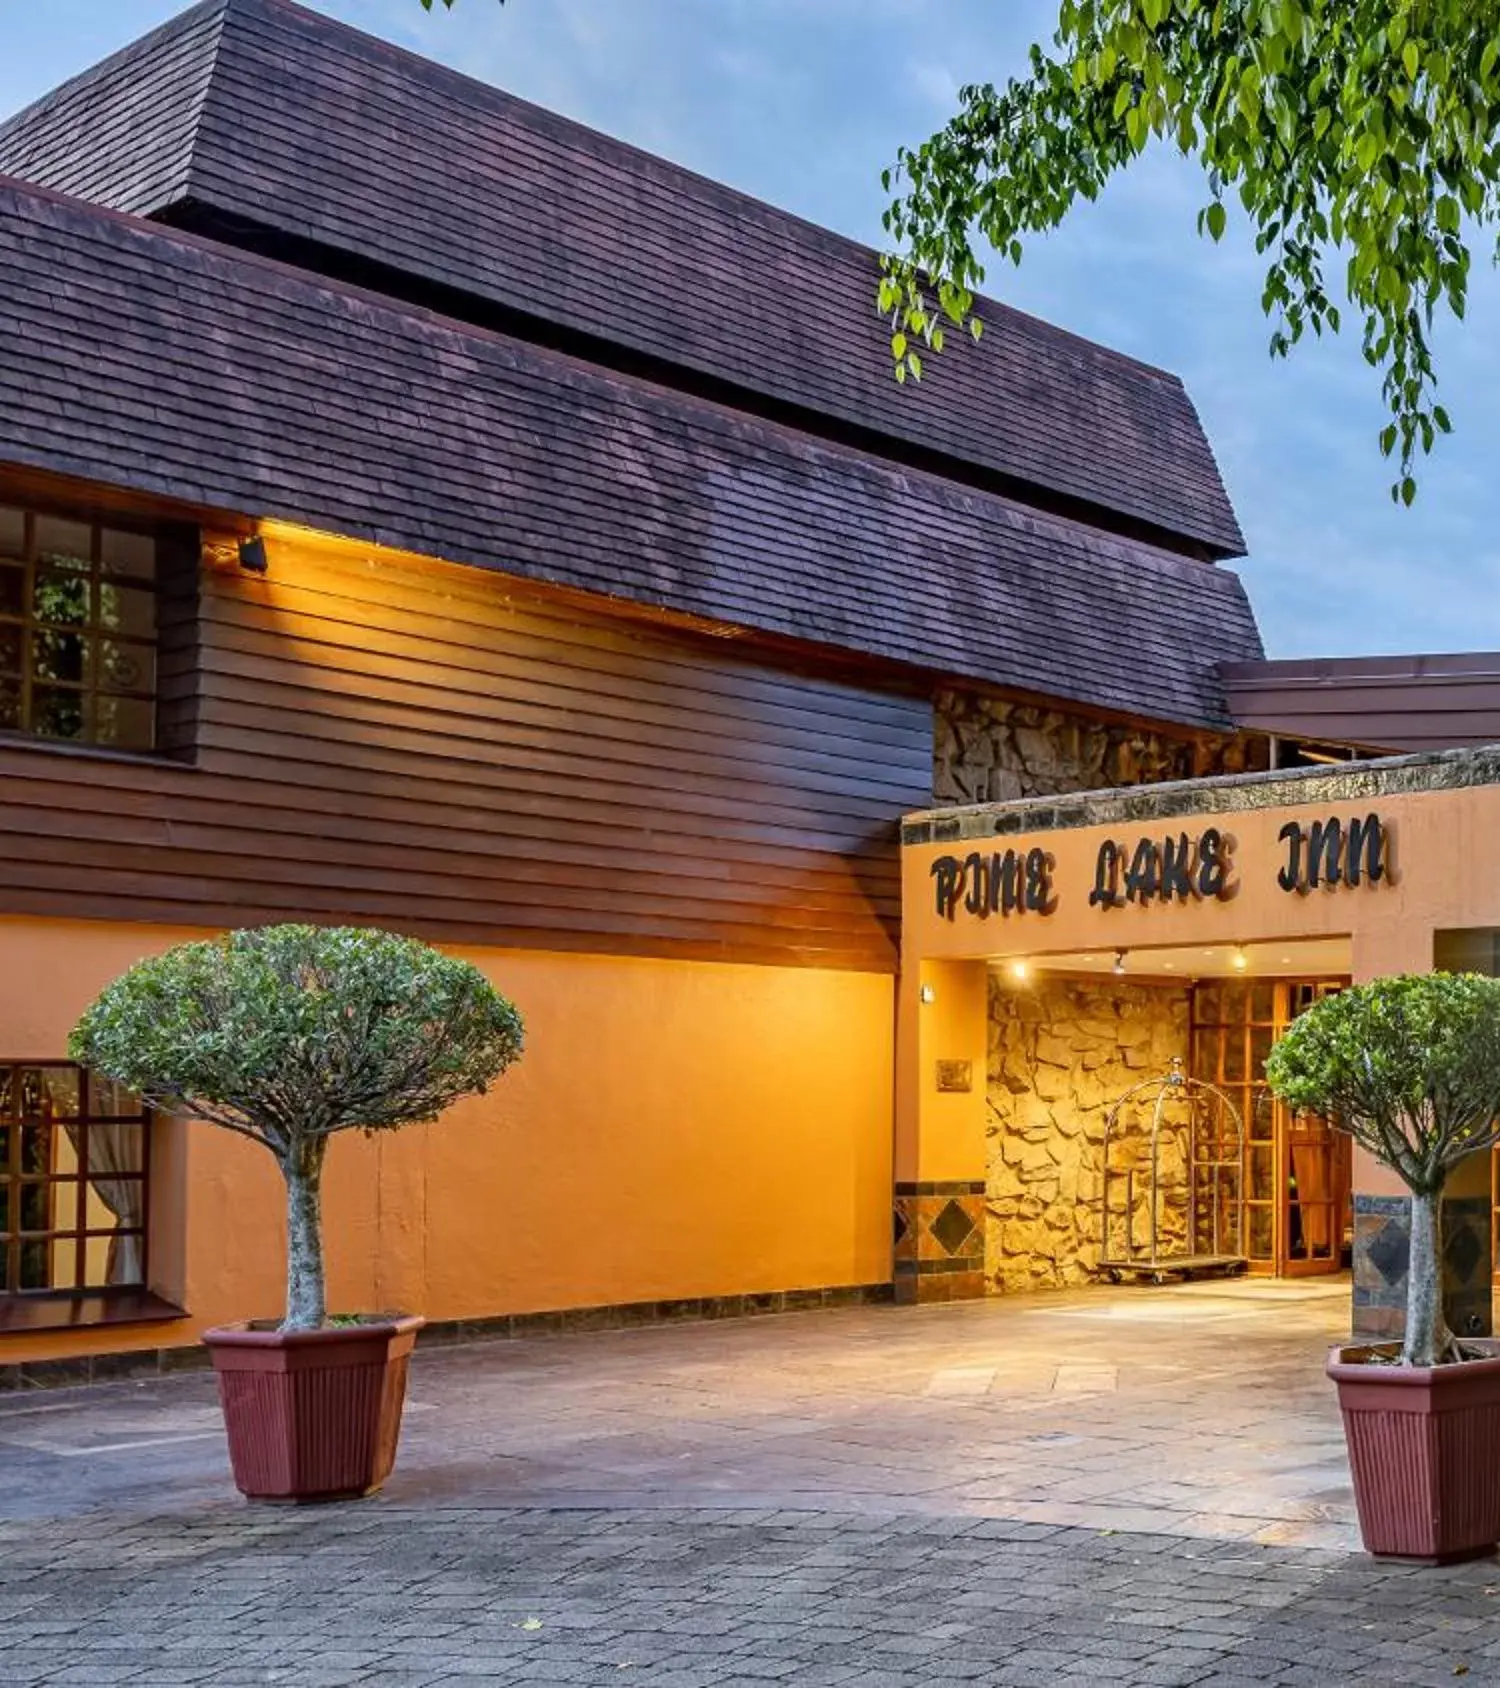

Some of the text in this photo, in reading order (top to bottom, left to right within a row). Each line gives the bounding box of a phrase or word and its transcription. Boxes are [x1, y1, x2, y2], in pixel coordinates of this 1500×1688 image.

[931, 812, 1385, 917] PINE LAKE INN
